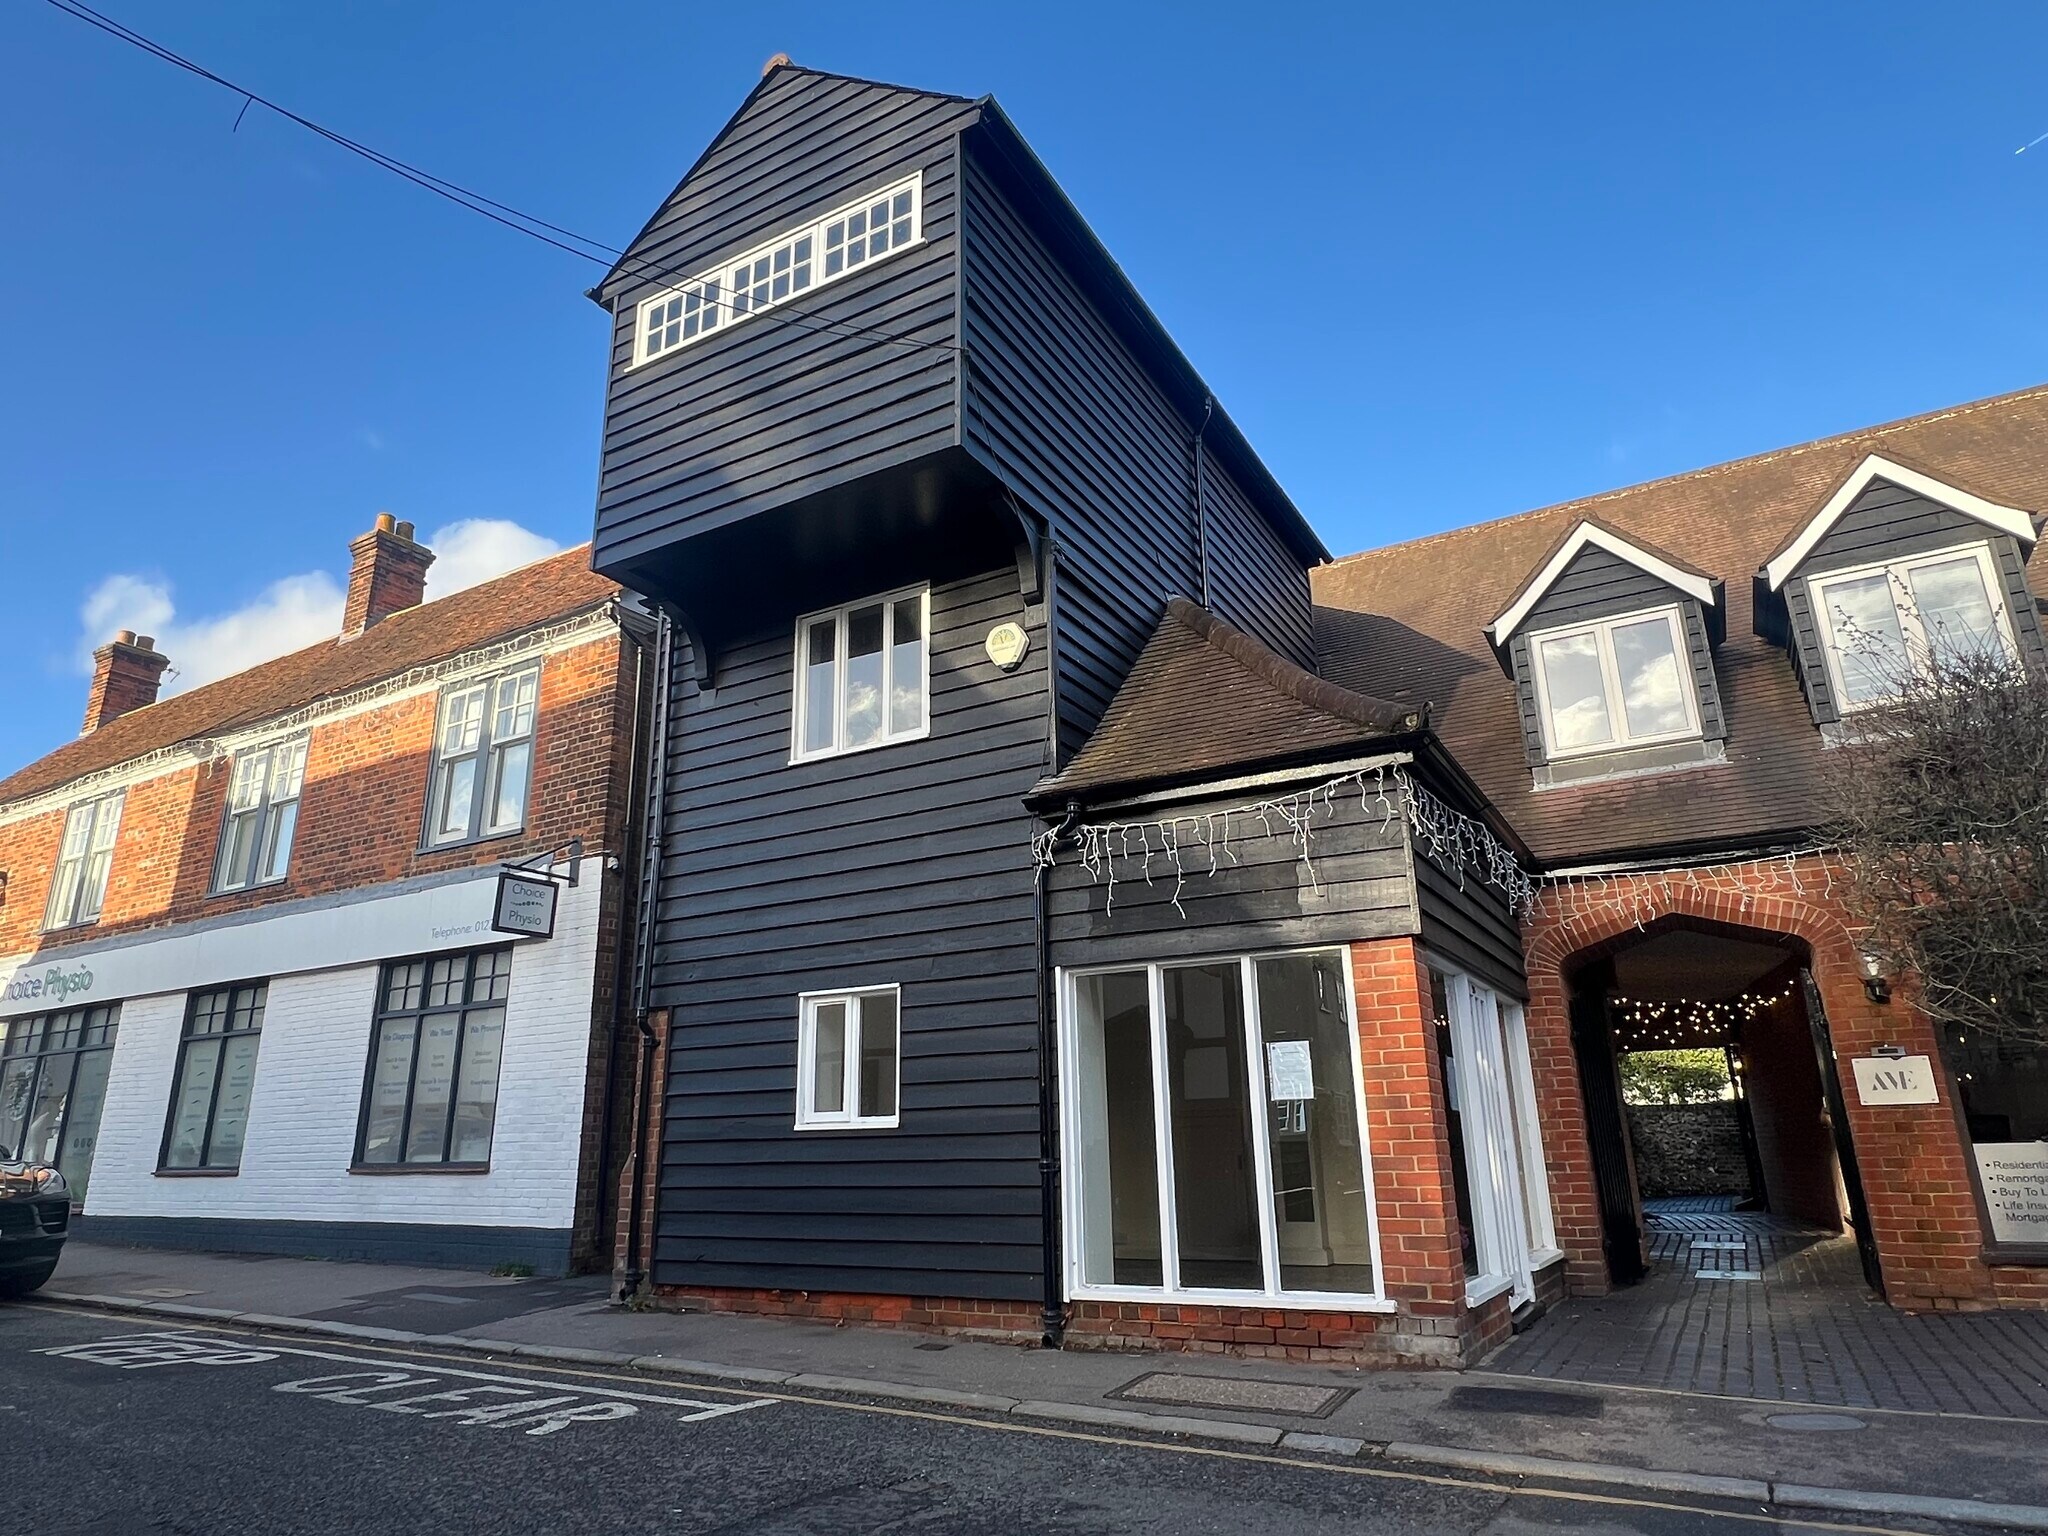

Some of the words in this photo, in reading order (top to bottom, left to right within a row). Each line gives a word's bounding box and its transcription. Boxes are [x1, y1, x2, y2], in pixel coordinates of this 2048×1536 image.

[512, 883, 546, 899] Choice
[475, 919, 493, 932] 012
[508, 910, 542, 926] Physio
[42, 963, 94, 1002] Physio
[2000, 1187, 2021, 1199] Buy
[2023, 1187, 2038, 1197] To
[2003, 1201, 2023, 1210] Life
[29, 1340, 281, 1369] KEEP
[270, 1372, 640, 1436] CLEAR
